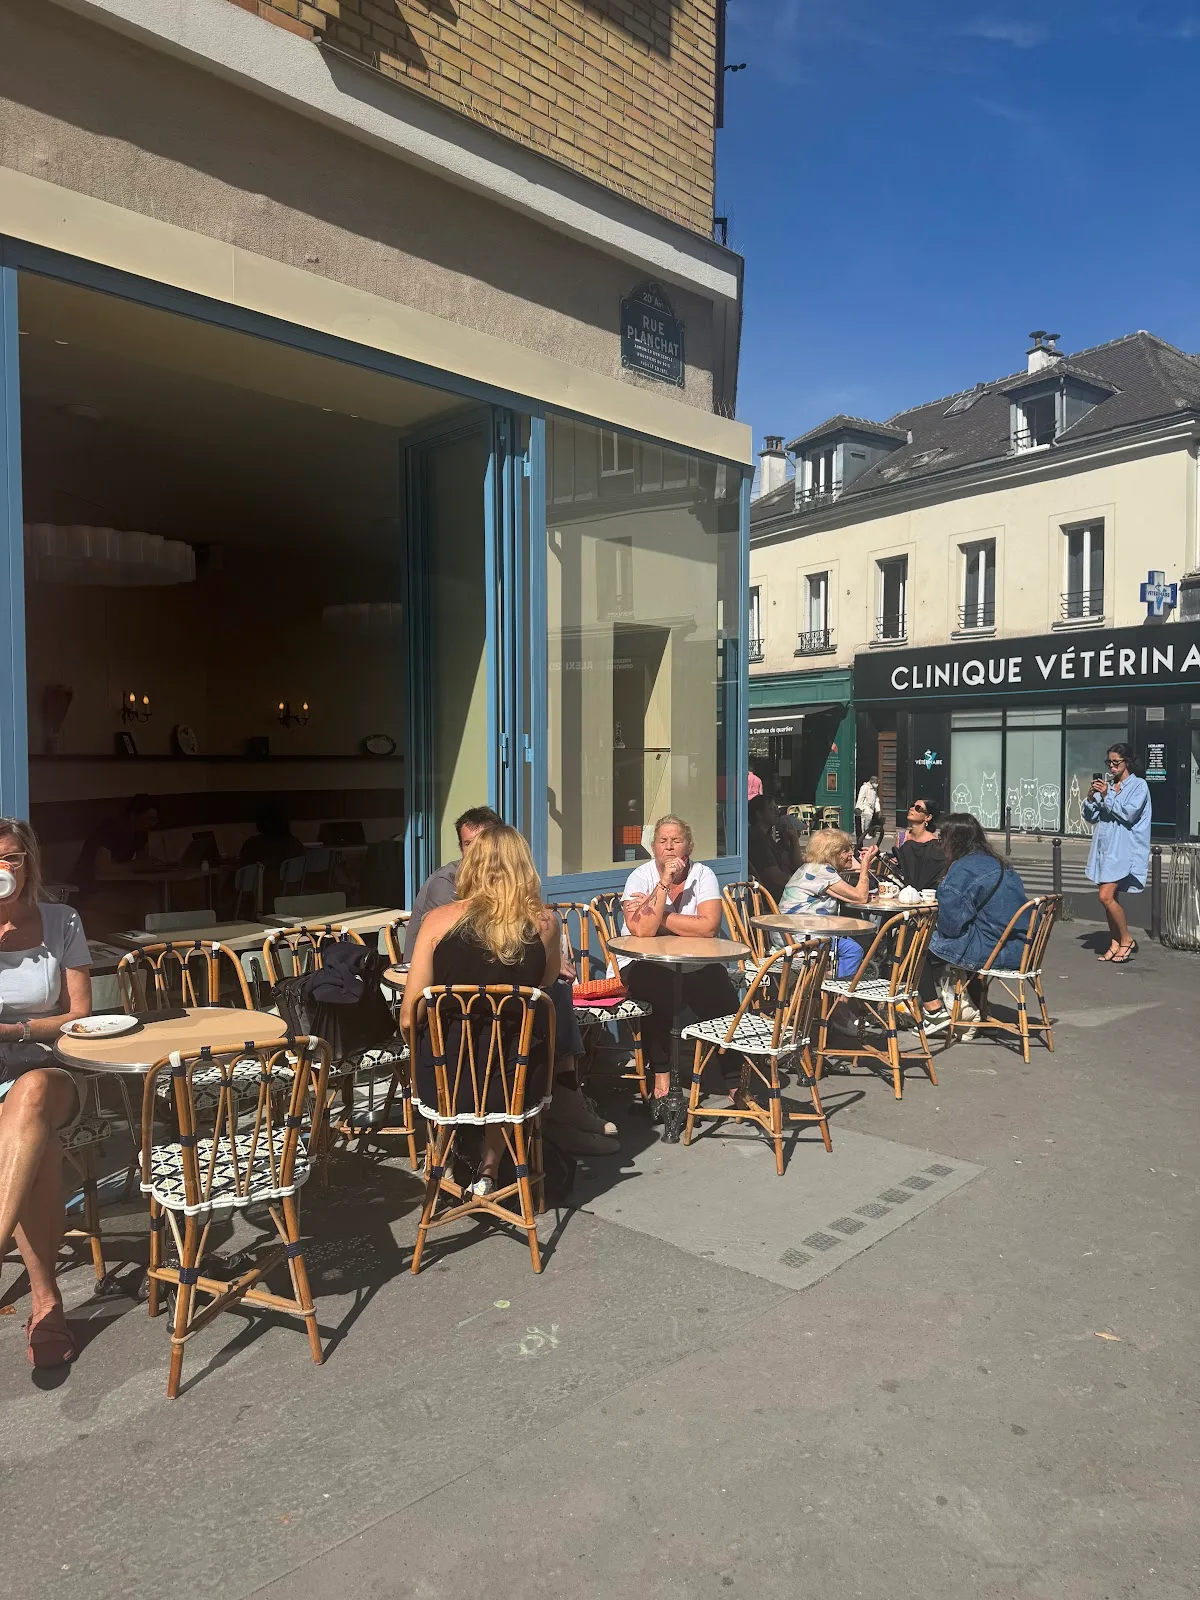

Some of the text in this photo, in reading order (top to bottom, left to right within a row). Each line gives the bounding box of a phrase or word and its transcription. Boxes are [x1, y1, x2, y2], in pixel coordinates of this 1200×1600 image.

[643, 315, 665, 336] RUE
[627, 325, 679, 357] PLANCHAT
[890, 656, 1023, 691] CLINIQUE
[776, 725, 793, 734] quartier
